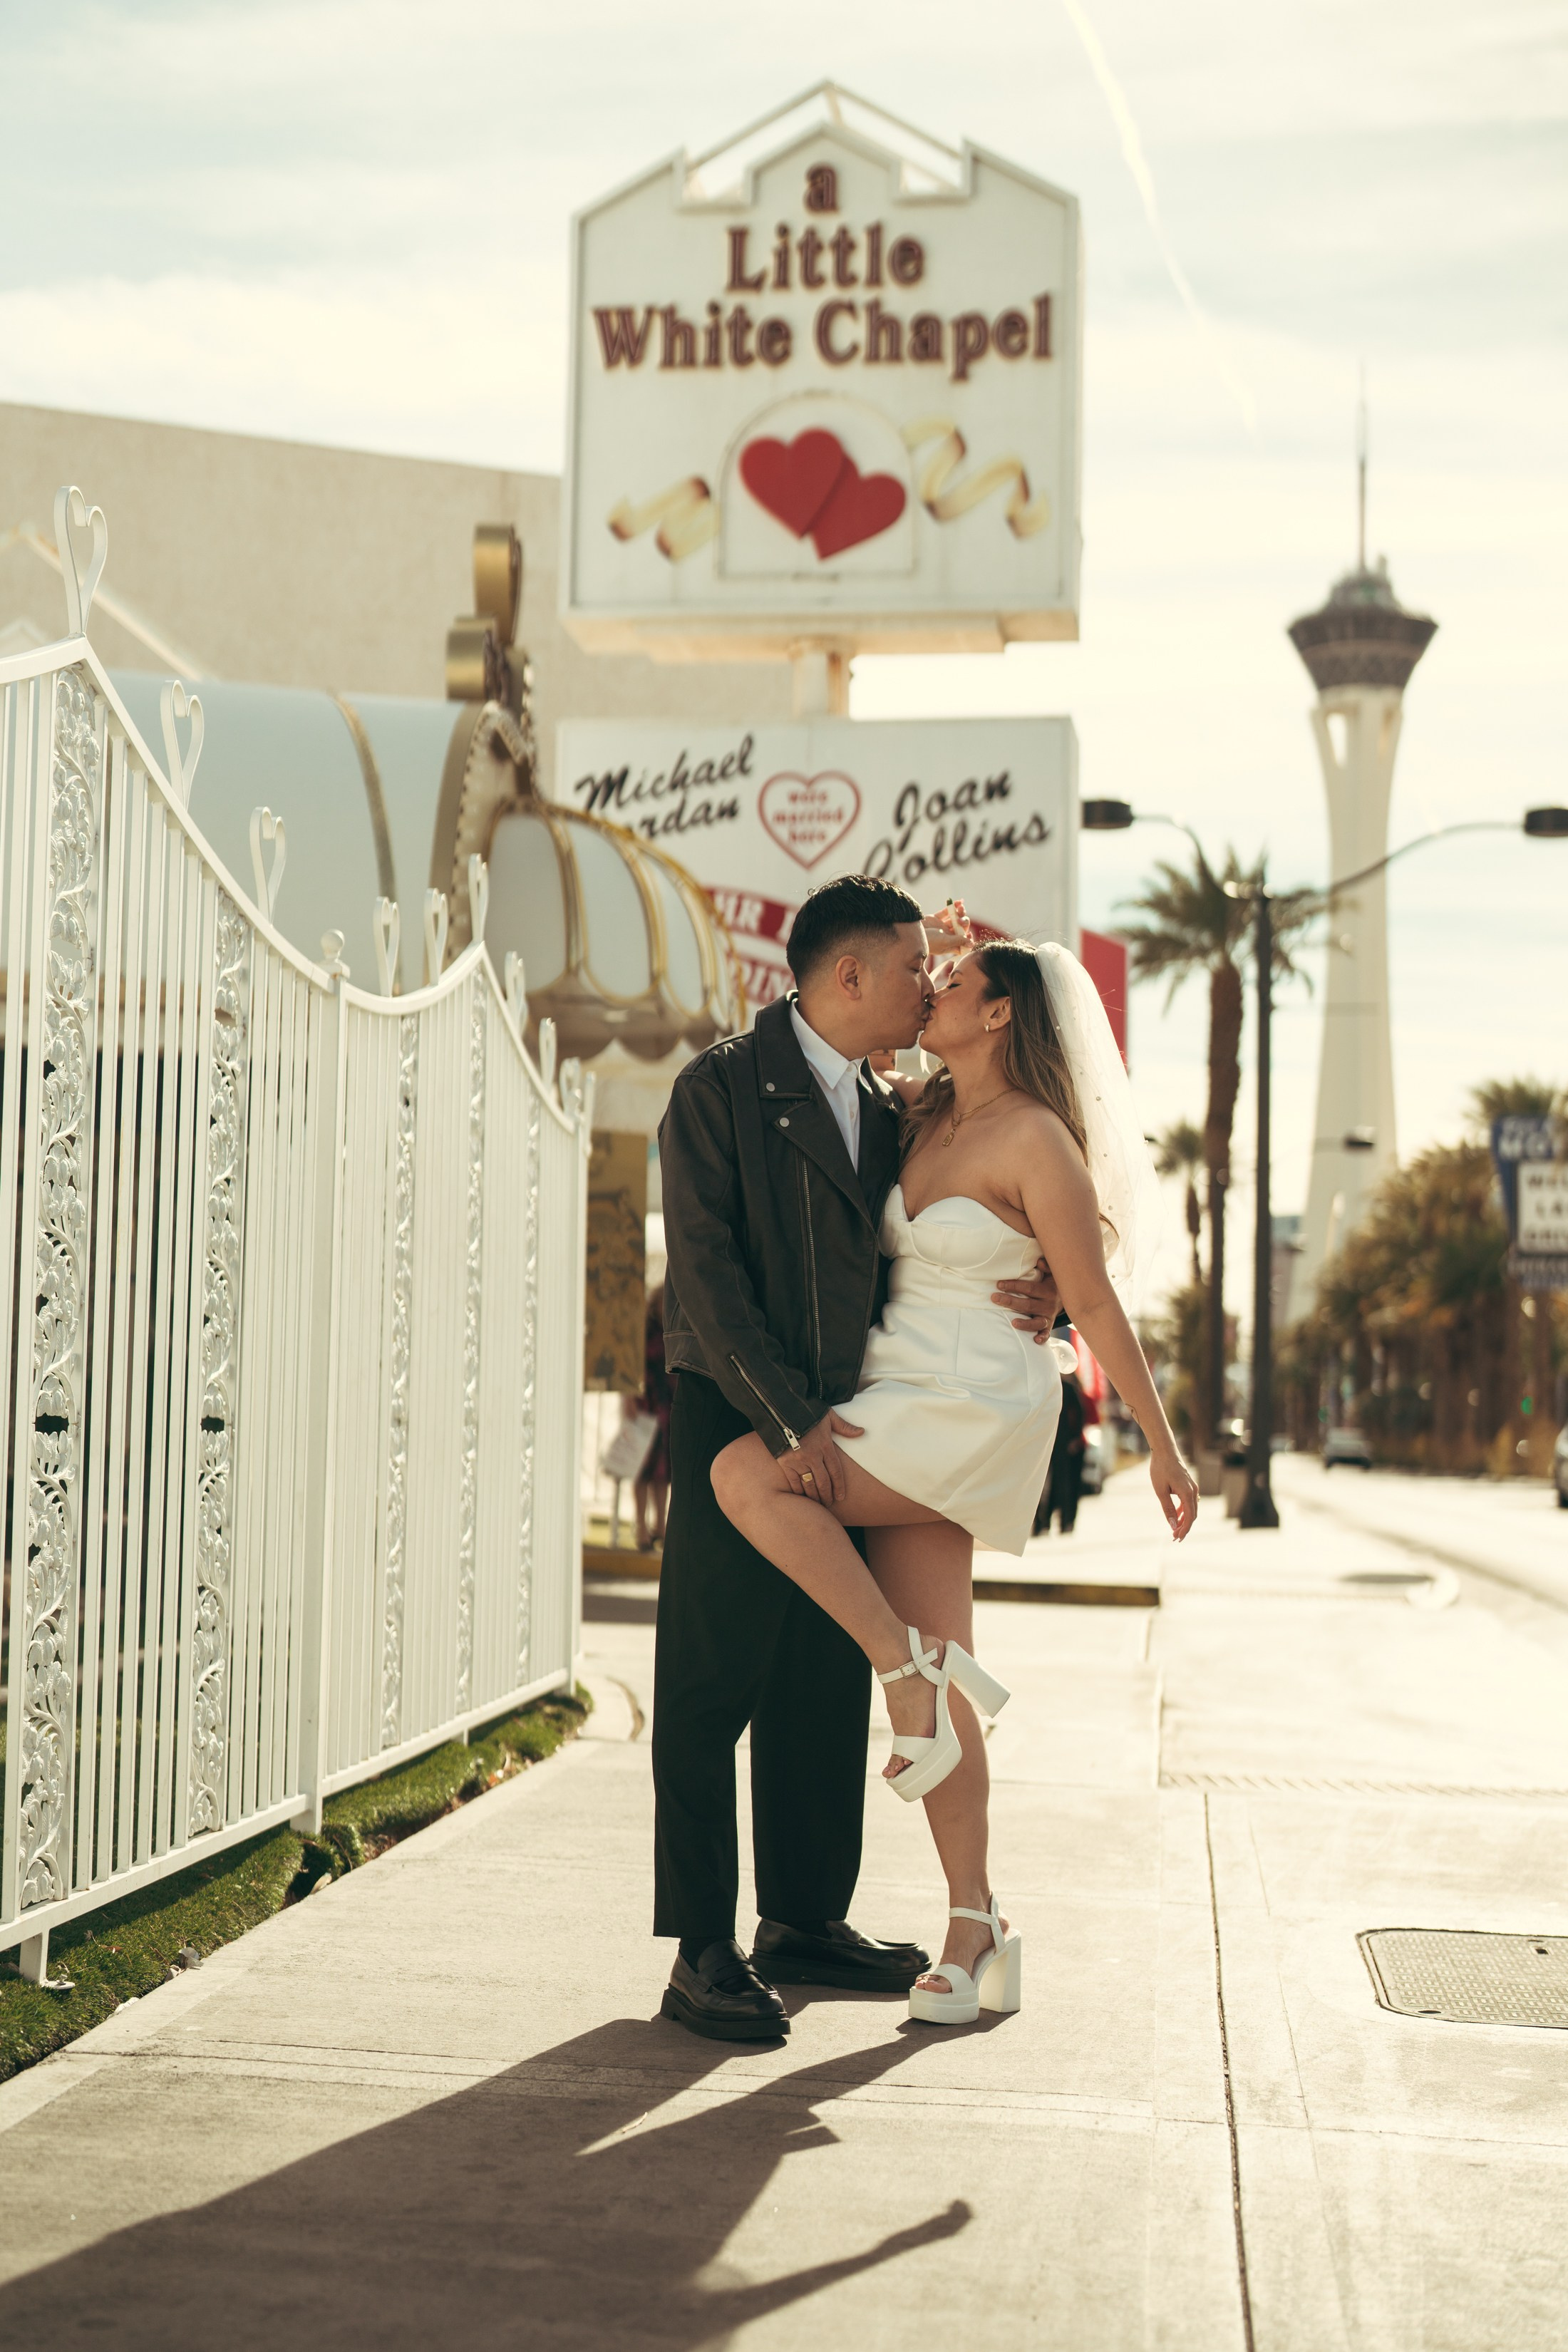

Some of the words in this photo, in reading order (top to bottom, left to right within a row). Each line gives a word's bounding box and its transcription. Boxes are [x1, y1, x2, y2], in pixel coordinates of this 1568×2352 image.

[803, 163, 840, 214] a
[724, 221, 926, 292] Little
[592, 299, 793, 369] White
[812, 291, 1053, 383] Chapel
[574, 733, 753, 811] Michael
[634, 796, 739, 839] rdan
[894, 770, 1010, 853] Joan
